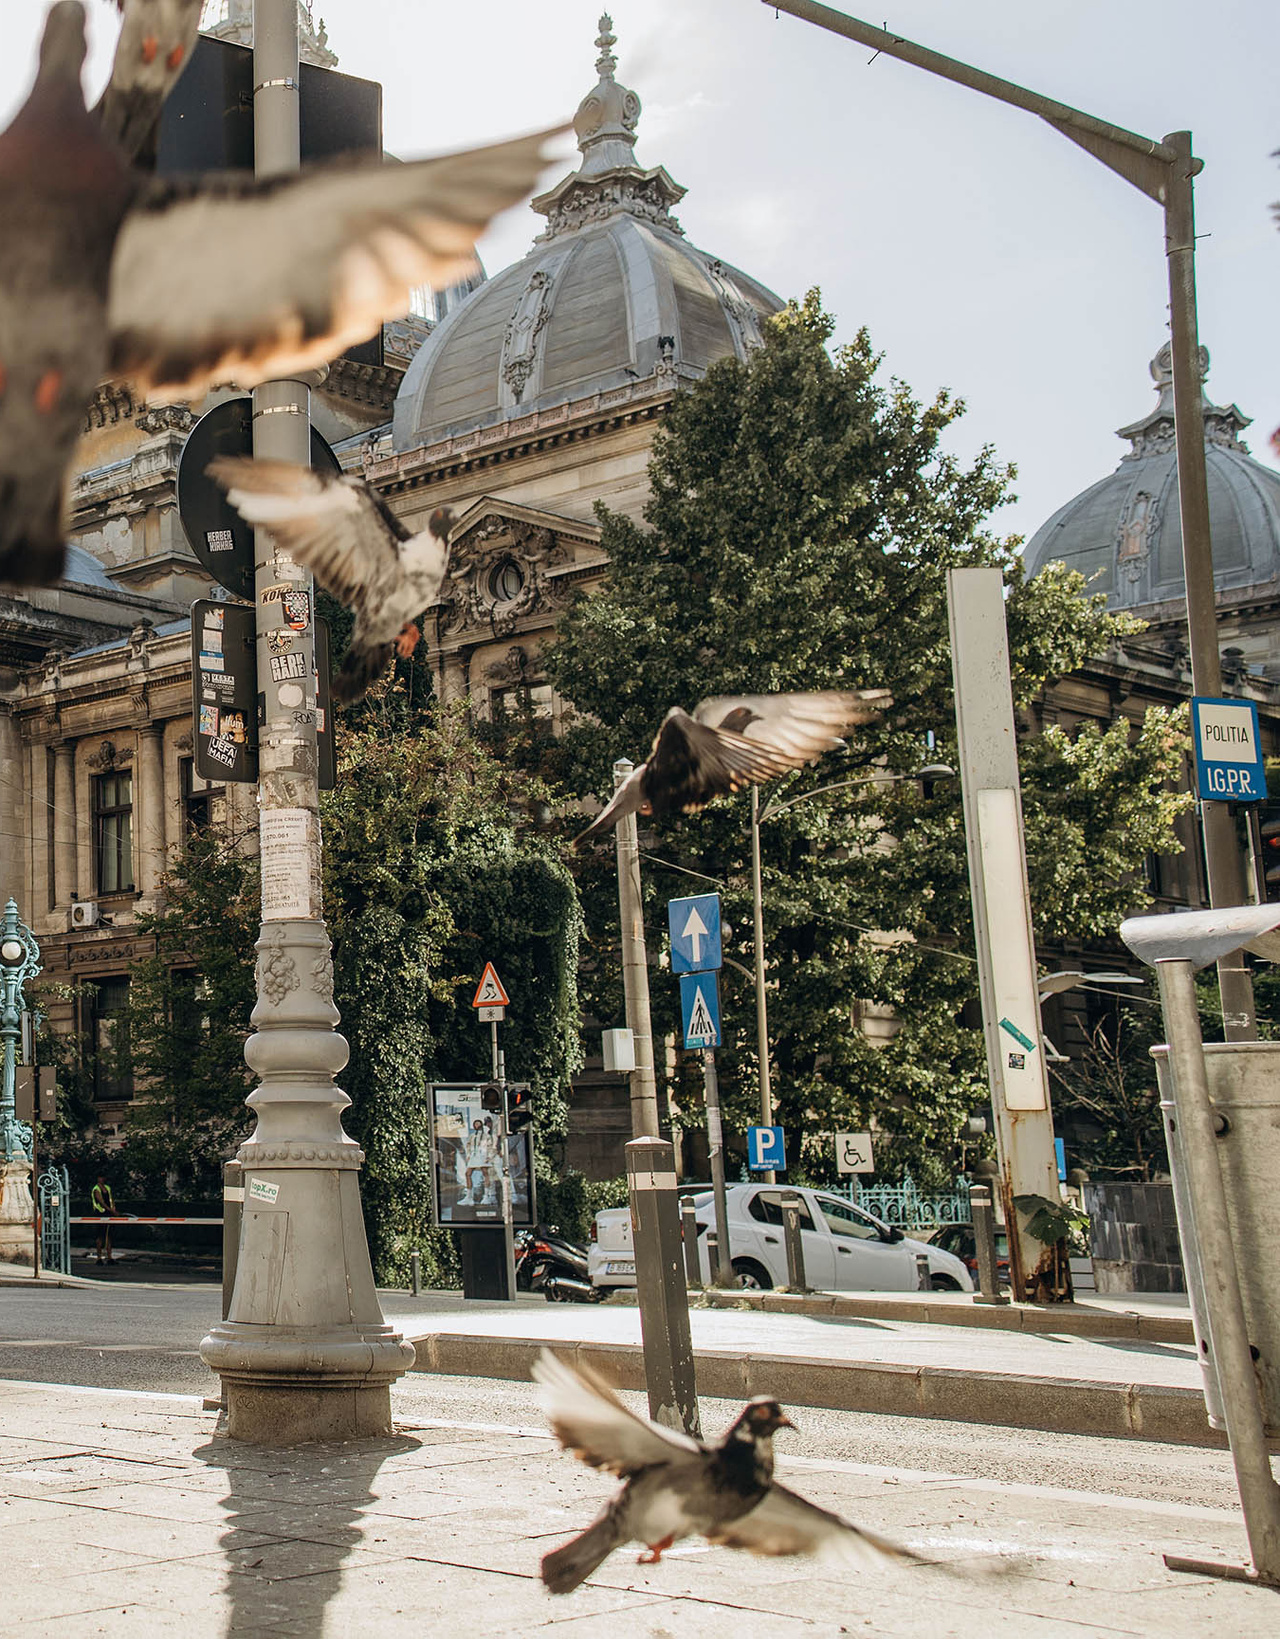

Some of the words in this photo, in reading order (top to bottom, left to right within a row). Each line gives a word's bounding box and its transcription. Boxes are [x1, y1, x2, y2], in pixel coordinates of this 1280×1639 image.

[209, 747, 234, 767] MAFIA
[212, 738, 235, 758] UEFA
[1207, 767, 1257, 794] I.G.P.R.
[756, 1128, 775, 1163] P
